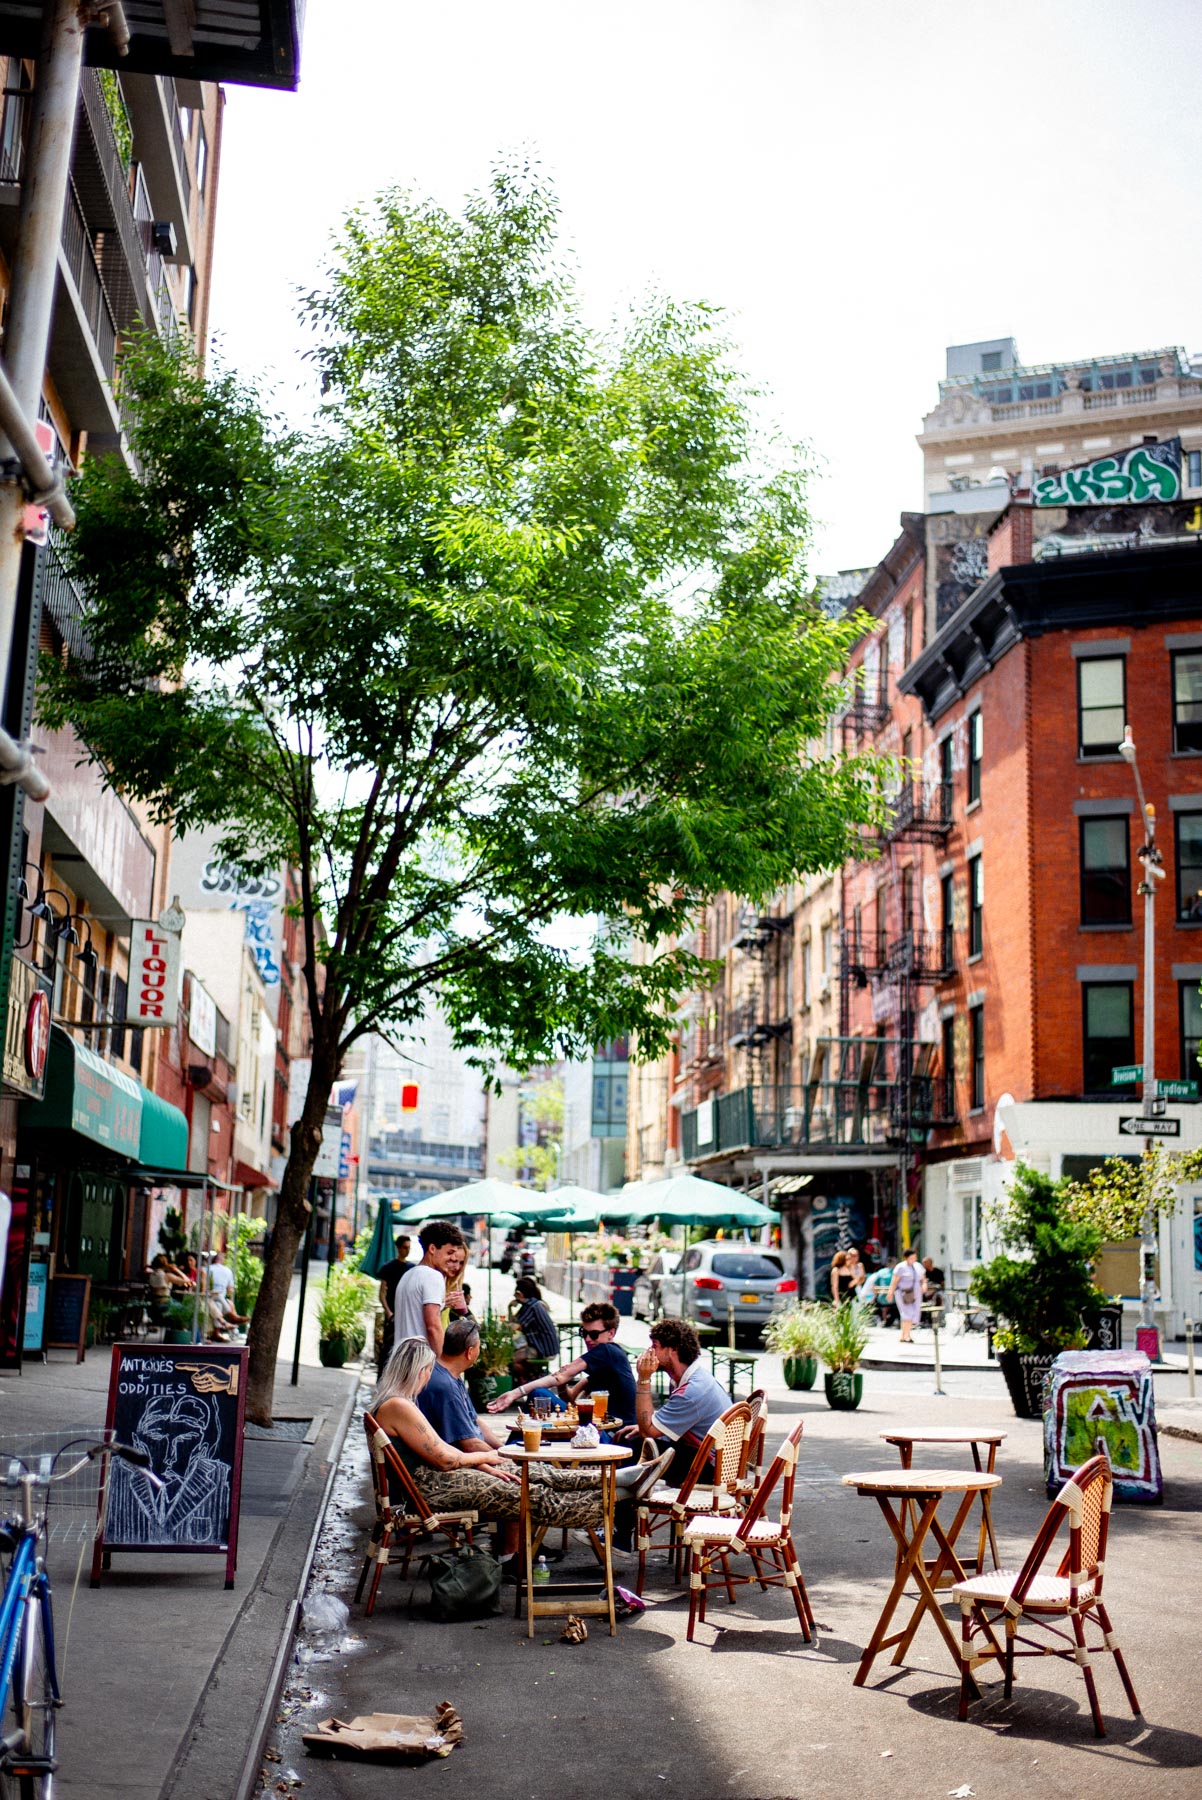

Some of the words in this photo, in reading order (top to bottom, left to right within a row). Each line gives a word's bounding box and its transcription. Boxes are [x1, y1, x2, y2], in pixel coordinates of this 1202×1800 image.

[140, 928, 168, 1017] LIQUOR
[1113, 1069, 1137, 1083] Division
[1158, 1081, 1189, 1095] Ludlow
[1127, 1121, 1145, 1131] ONE
[1153, 1121, 1173, 1132] WAY
[119, 1382, 187, 1396] ODDITIES
